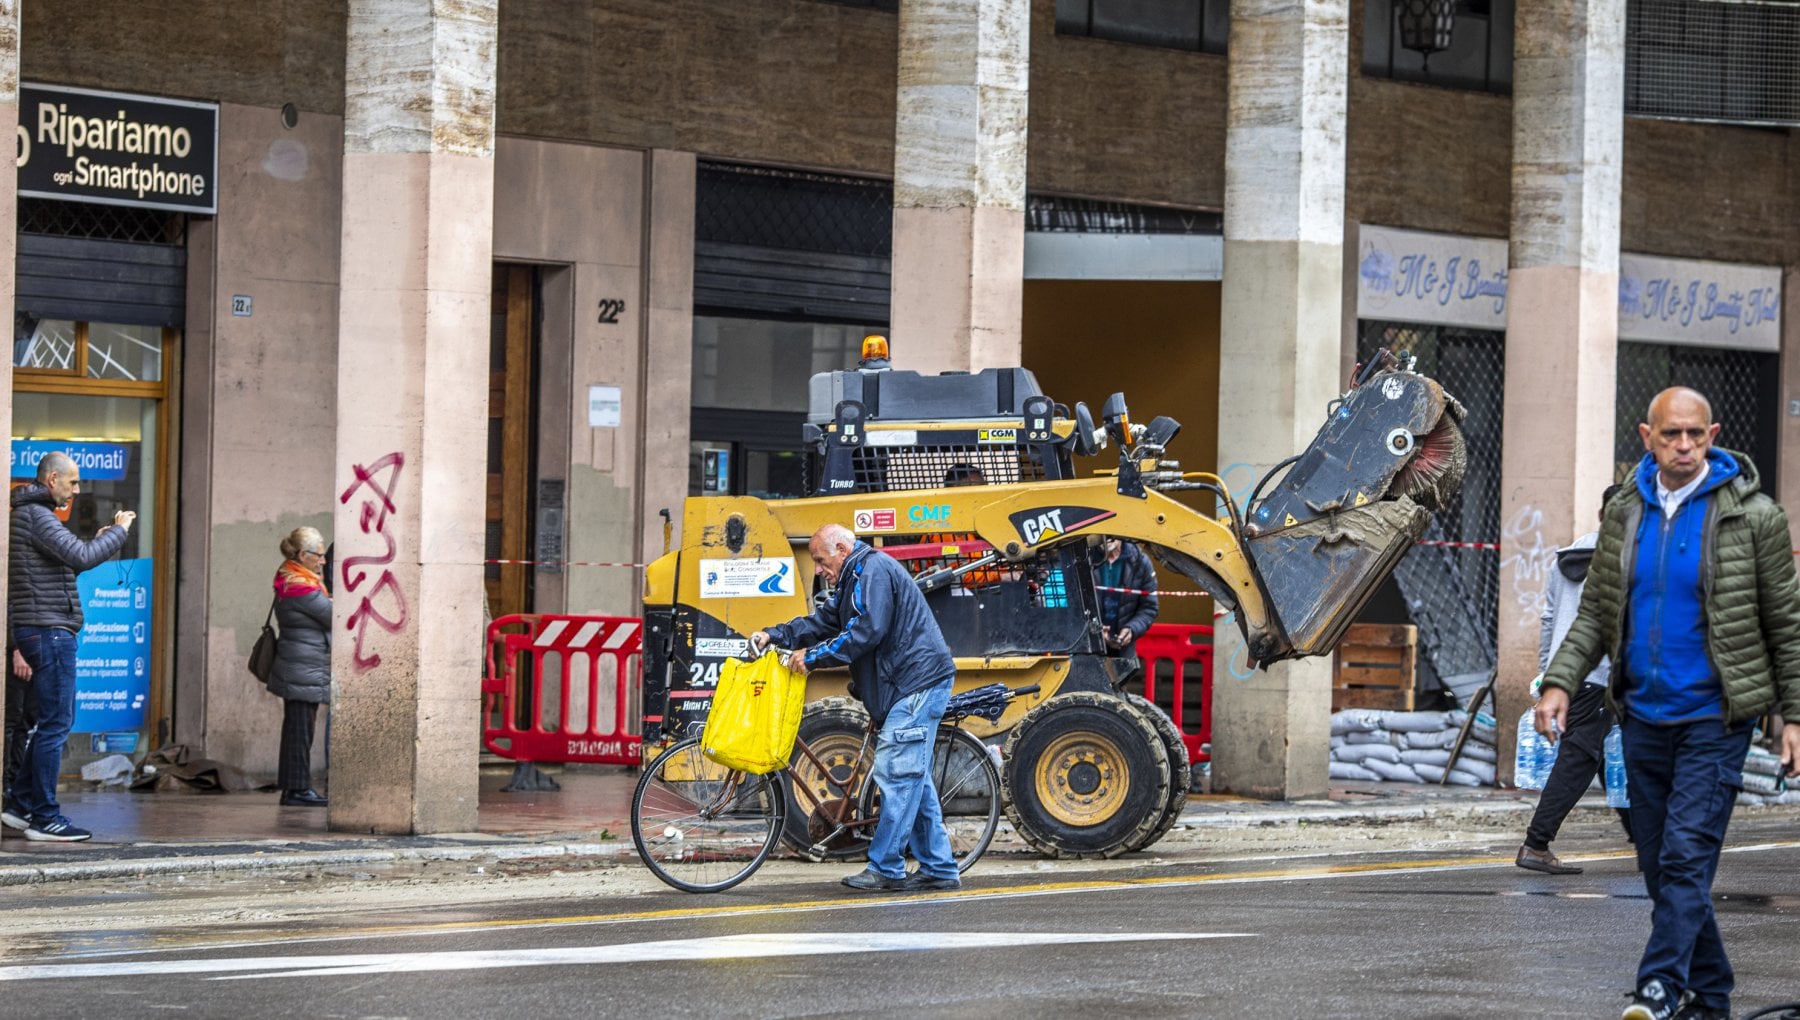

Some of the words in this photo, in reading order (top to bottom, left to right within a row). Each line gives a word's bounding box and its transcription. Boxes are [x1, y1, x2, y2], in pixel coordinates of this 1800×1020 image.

[38, 102, 191, 158] Ripariamo
[53, 171, 73, 185] ogni
[75, 156, 205, 198] Smartphone
[991, 429, 1014, 438] CGM
[908, 504, 953, 522] CMF
[1022, 508, 1065, 545] CAT
[95, 588, 130, 598] Preventivi
[84, 622, 129, 634] Applicazione
[690, 662, 726, 687] 24
[112, 689, 127, 700] dati
[682, 700, 701, 711] HIGH
